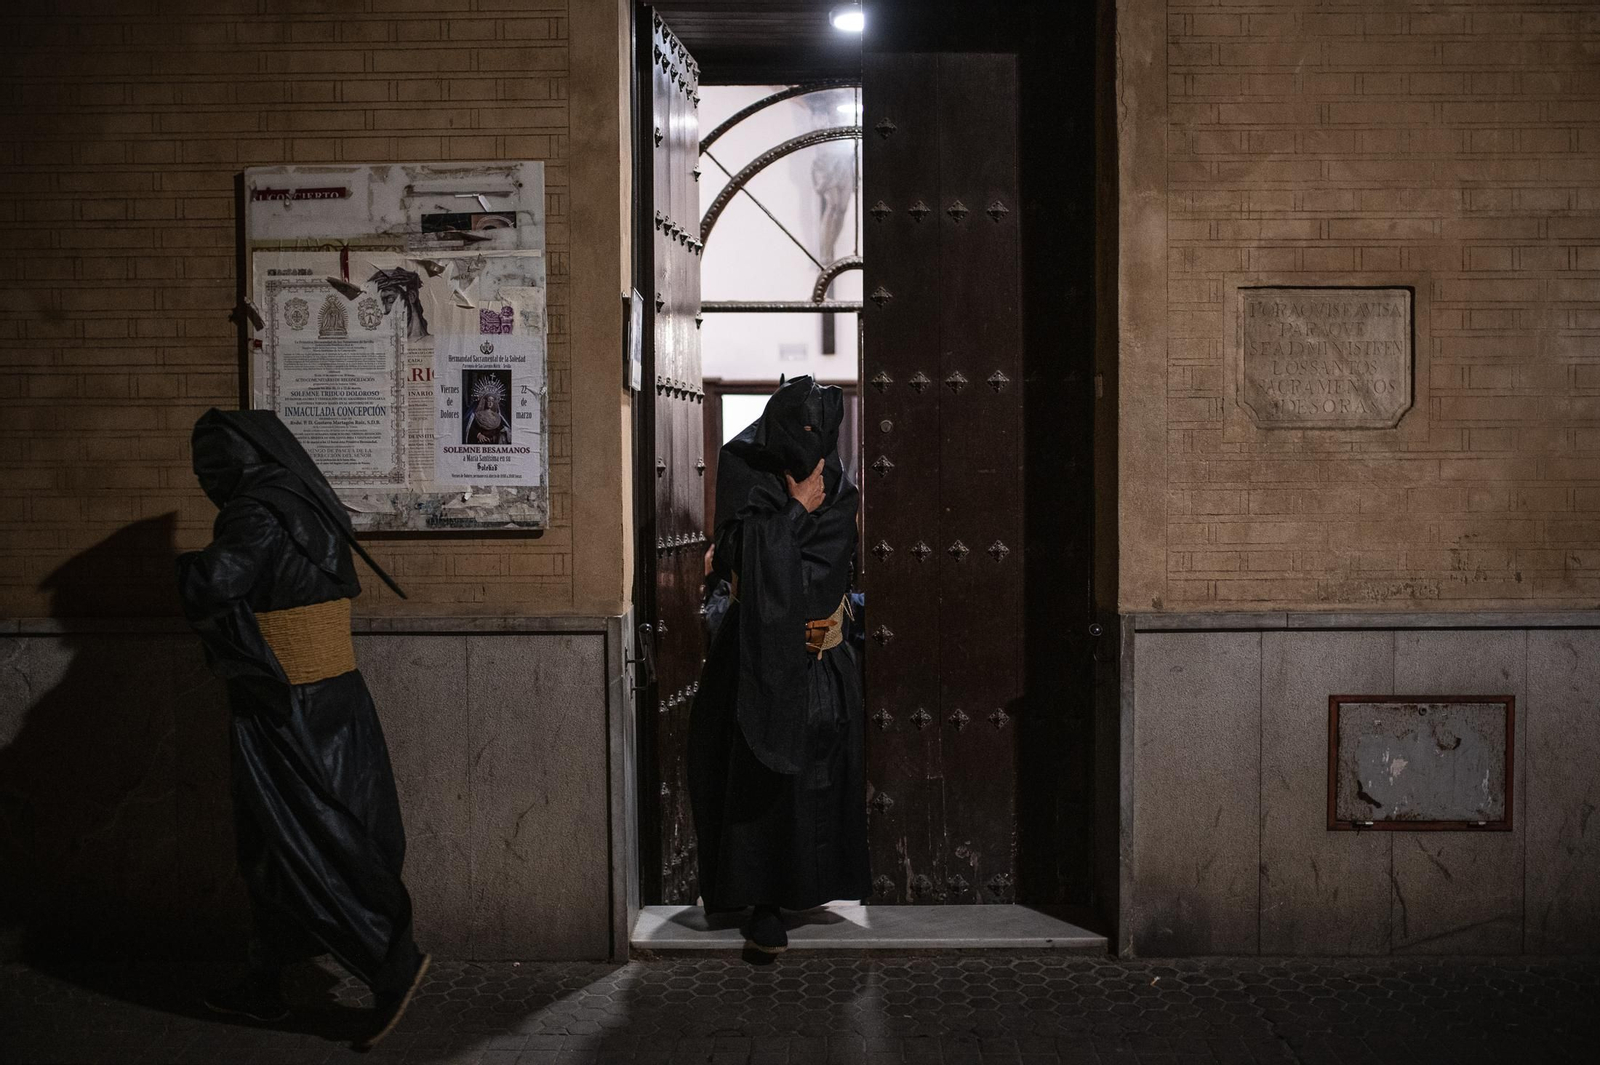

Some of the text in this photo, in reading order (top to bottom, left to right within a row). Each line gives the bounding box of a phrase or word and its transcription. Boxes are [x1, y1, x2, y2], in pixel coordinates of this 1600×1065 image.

[448, 354, 472, 363] Hermandad
[473, 354, 498, 363] Sacramental
[499, 354, 504, 363] de
[509, 354, 526, 363] Soledad
[440, 385, 460, 394] Viernes
[521, 385, 528, 394] 22
[446, 397, 453, 406] de
[521, 397, 528, 406] de
[284, 404, 386, 417] INMACULADA CONCEPCIÓN
[440, 410, 460, 419] Dolores
[443, 446, 531, 454] SOLEMNE BESAMANOS
[466, 454, 478, 462] María
[479, 454, 499, 462] Santísima
